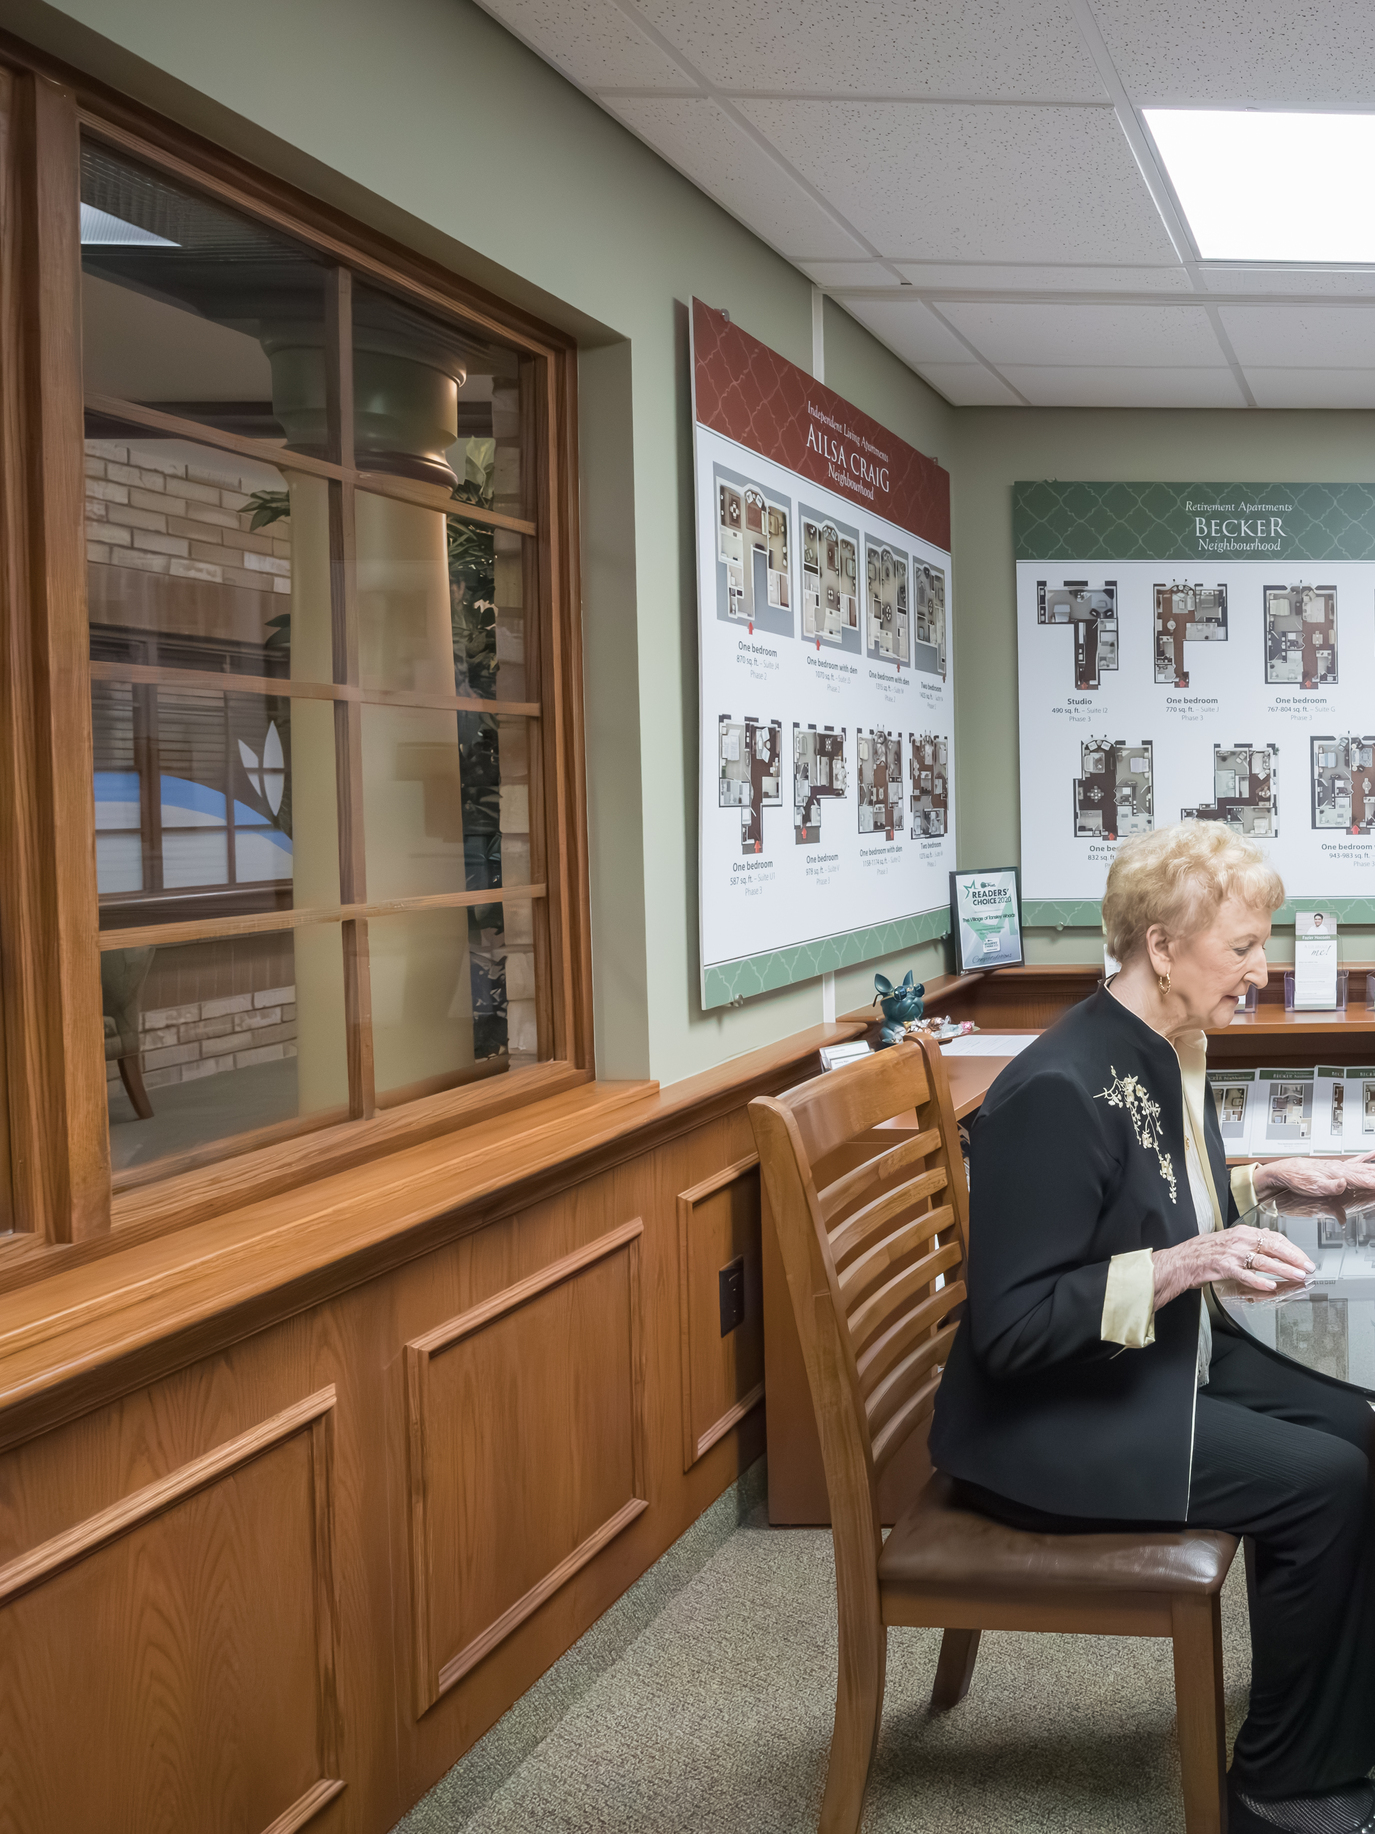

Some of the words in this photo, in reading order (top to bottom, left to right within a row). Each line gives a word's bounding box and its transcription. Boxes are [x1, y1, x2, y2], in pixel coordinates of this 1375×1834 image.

[807, 400, 843, 434] Independent
[843, 423, 861, 447] Living
[861, 436, 889, 463] Apartments
[806, 423, 847, 469] AILSA
[850, 453, 890, 493] CRAIG
[828, 462, 875, 501] Neighbourhood
[1185, 500, 1235, 511] Retirement
[1238, 501, 1293, 513] Apartments
[1194, 517, 1288, 537] BECKER
[1198, 538, 1281, 553] Neighbourhood
[738, 640, 751, 652] One
[751, 642, 778, 658] bedroom
[806, 655, 817, 667] One
[817, 657, 839, 671] bedroom
[839, 663, 850, 673] with
[849, 664, 858, 675] den
[868, 669, 877, 679] One
[877, 671, 894, 683] bedroom
[1183, 696, 1219, 704] bedroom
[1292, 696, 1327, 704] bedroom
[859, 848, 869, 857] One
[868, 846, 886, 856] bedroom
[886, 845, 896, 854] with
[895, 844, 903, 853] den
[927, 841, 942, 850] bedroom
[806, 855, 817, 864] One
[817, 852, 839, 863] bedroom
[732, 862, 746, 872] One
[746, 859, 774, 871] bedroom
[729, 876, 740, 886] 587
[757, 872, 769, 883] Suite
[744, 887, 759, 896] Phase
[972, 888, 1010, 899] READERS'
[972, 897, 997, 906] CHOICE
